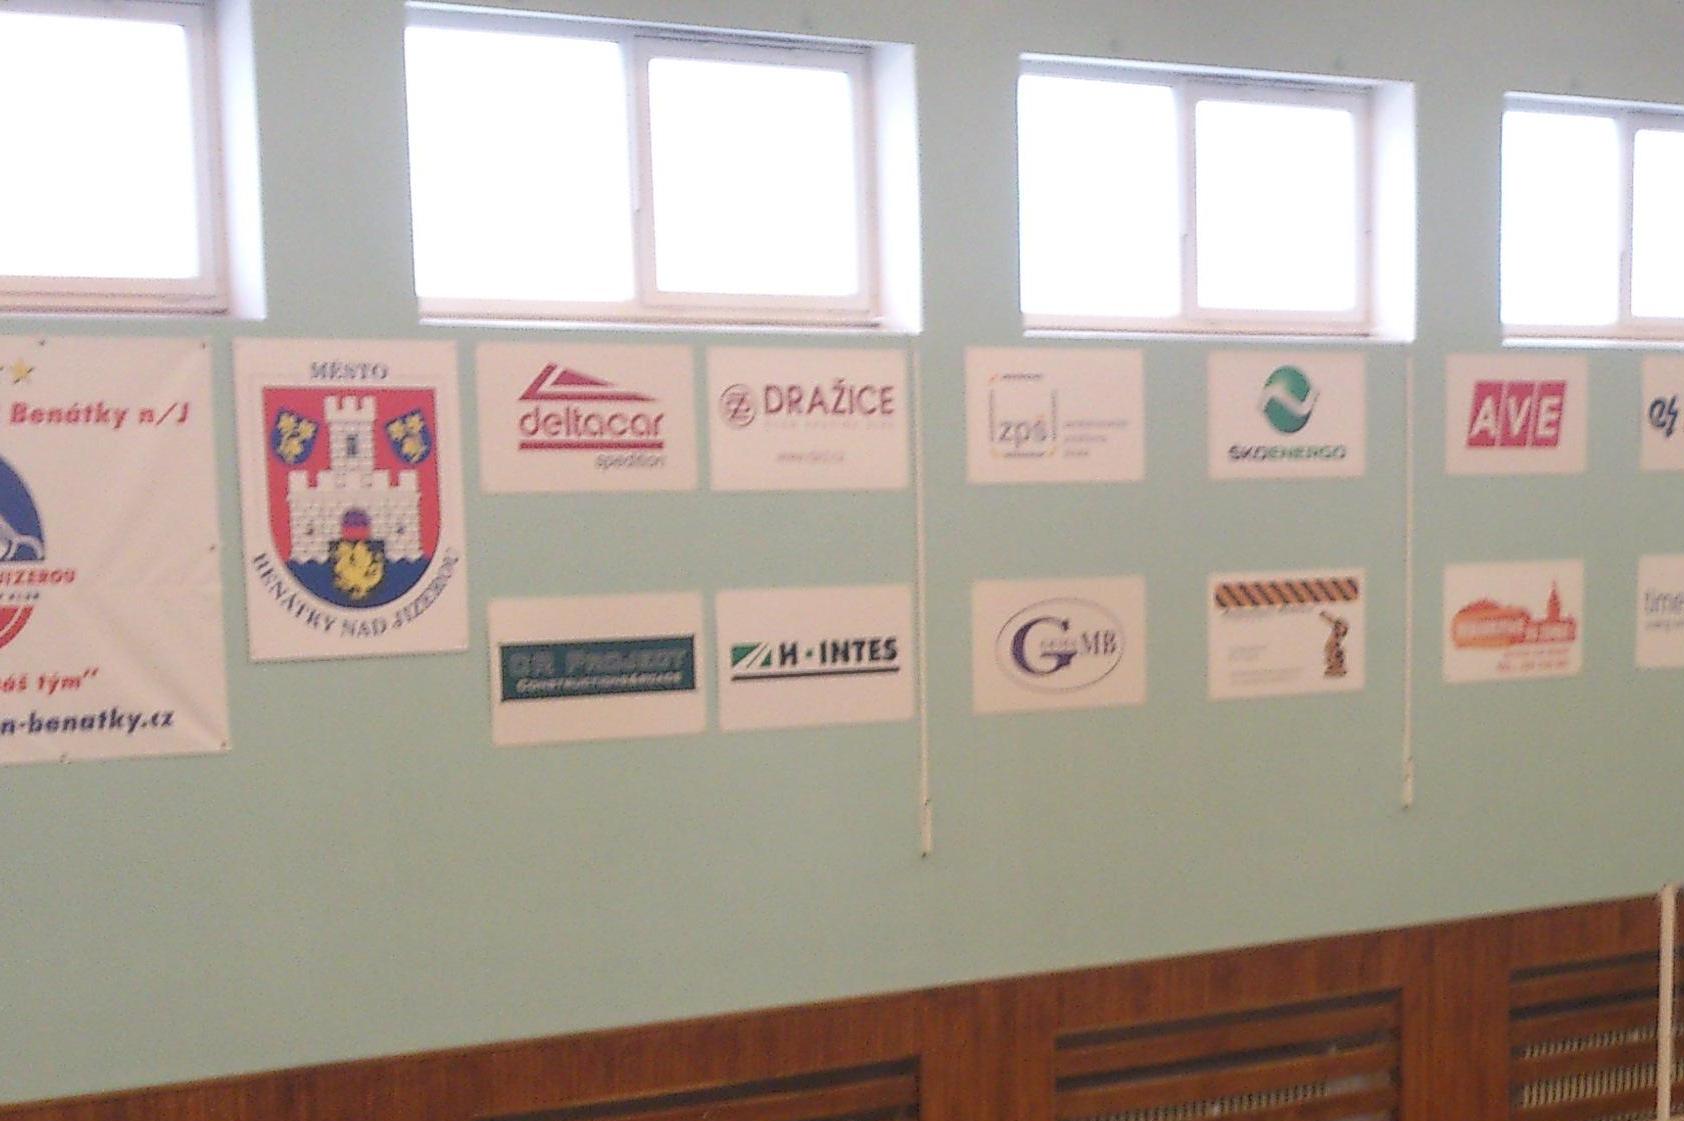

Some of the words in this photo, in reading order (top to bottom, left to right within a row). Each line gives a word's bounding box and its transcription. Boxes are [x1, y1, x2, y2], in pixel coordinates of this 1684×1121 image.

[765, 378, 895, 416] DRAŽICE
[10, 400, 128, 430] Benátky
[519, 407, 664, 436] deltacar
[1470, 395, 1561, 438] AVE
[820, 637, 898, 664] INTES
